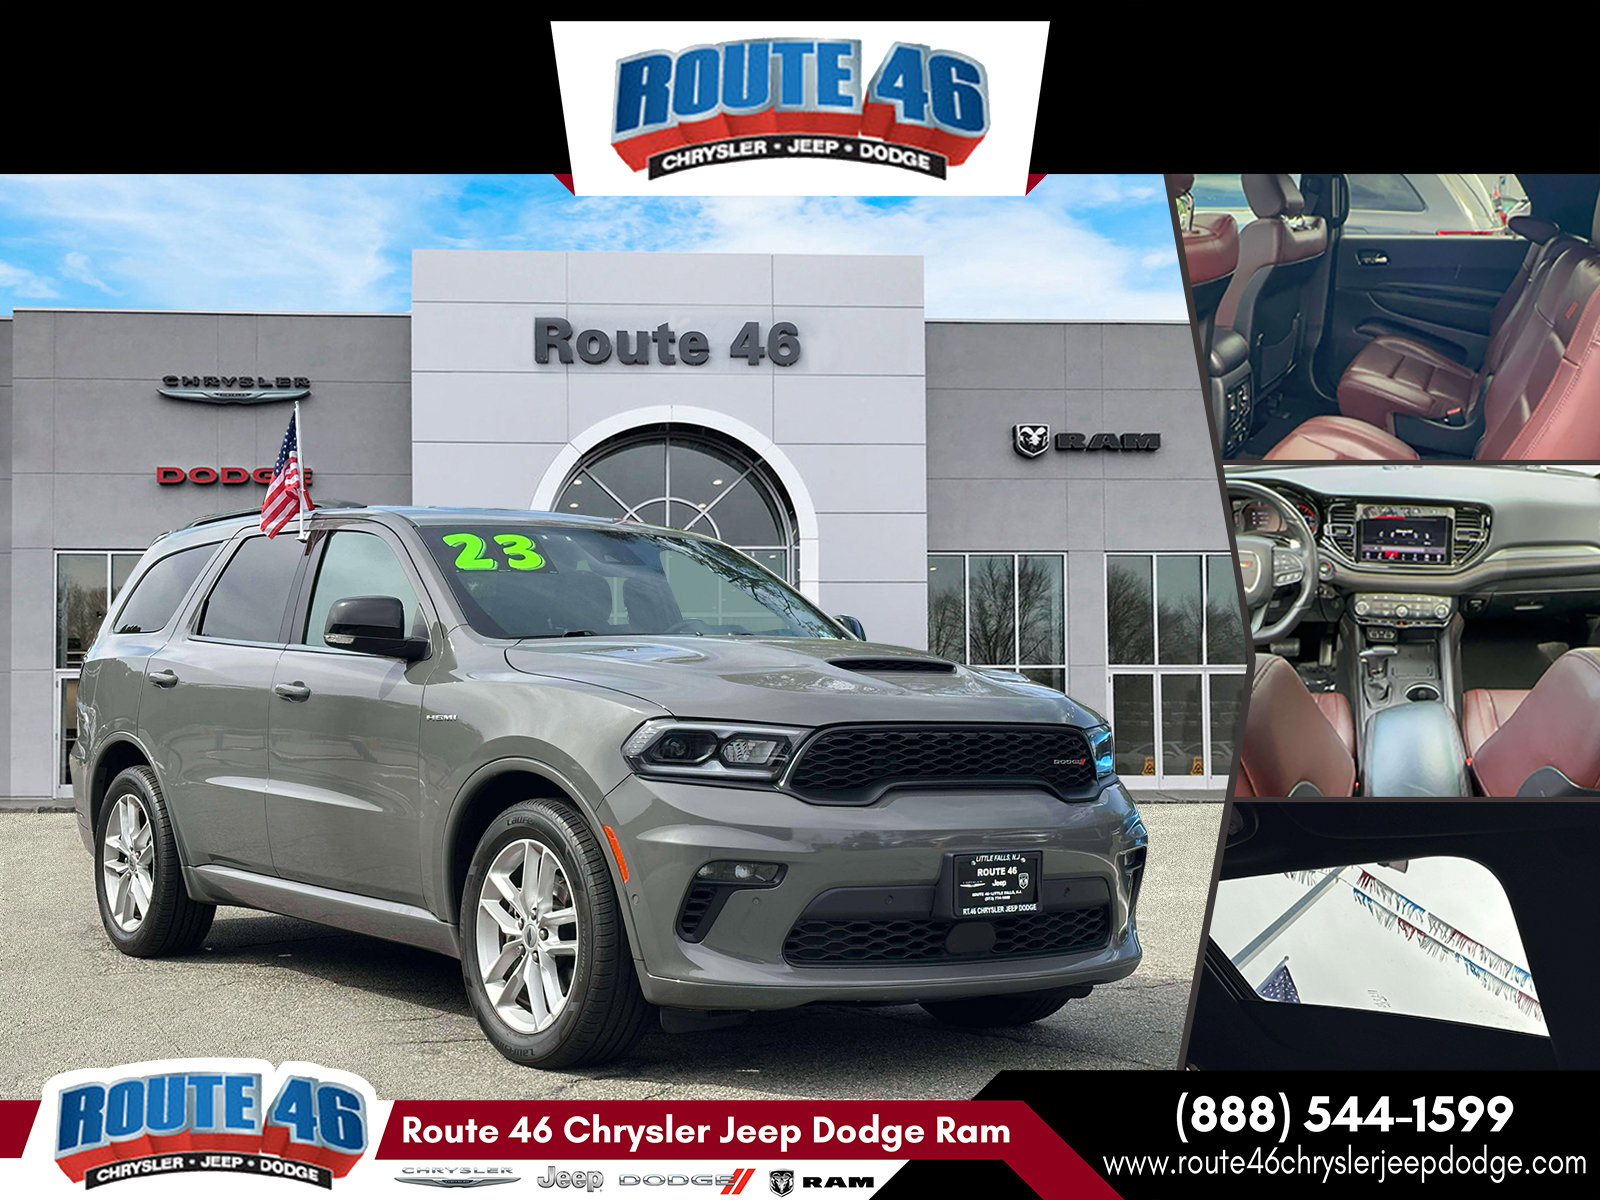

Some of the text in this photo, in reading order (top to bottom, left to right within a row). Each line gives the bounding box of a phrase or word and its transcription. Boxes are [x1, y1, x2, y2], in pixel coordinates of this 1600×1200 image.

[534, 317, 801, 367] Route 46
[162, 375, 310, 389] CHRYSLER
[1054, 432, 1161, 452] RAM
[442, 533, 546, 571] 23
[976, 855, 993, 863] LITTLE
[977, 867, 1018, 877] ROUTE 46
[977, 906, 1004, 914] CHRYSLER
[1005, 905, 1018, 913] JEEP
